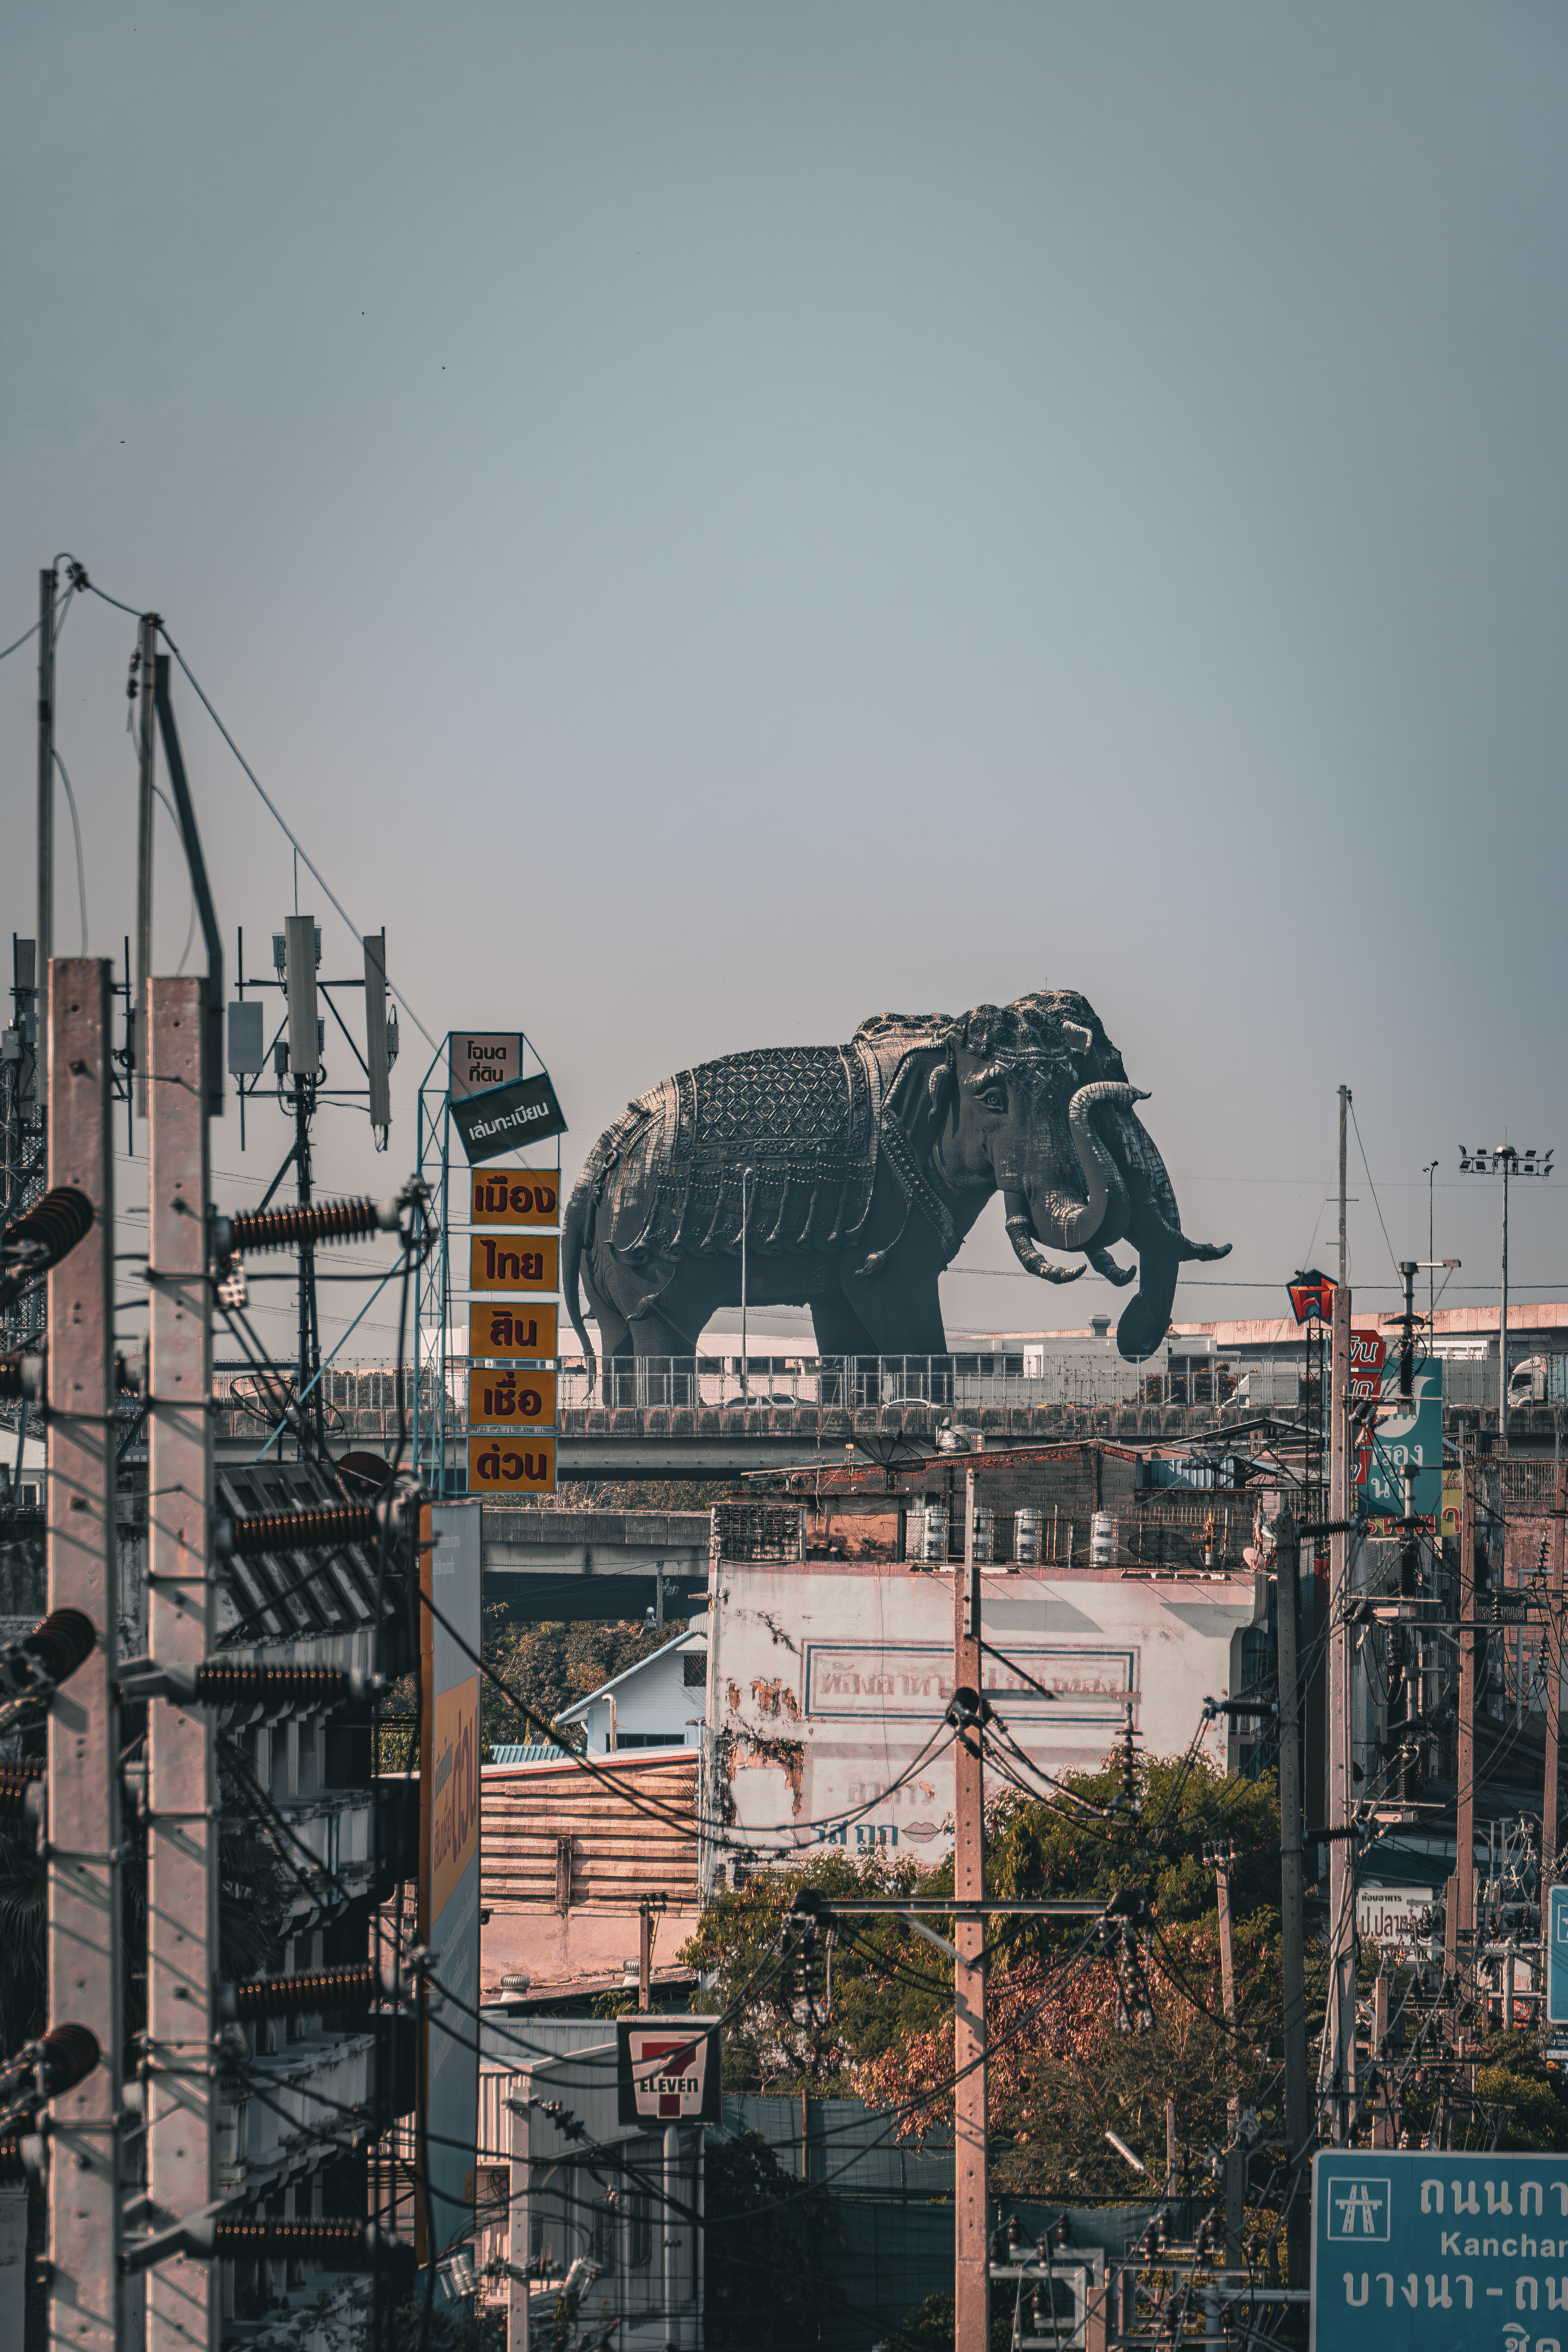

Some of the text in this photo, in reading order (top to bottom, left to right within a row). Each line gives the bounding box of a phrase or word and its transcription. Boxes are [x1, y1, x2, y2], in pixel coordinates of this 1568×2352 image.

[466, 1040, 506, 1060] โฉนด
[469, 1061, 504, 1082] ที่ดิน
[468, 1102, 549, 1140] เล่มทะเบียน
[475, 1175, 557, 1214] เมือง
[480, 1240, 543, 1281] ไทย
[490, 1310, 537, 1347] สิน
[483, 1372, 542, 1417] เชื่อ
[476, 1439, 547, 1482] ด่วน
